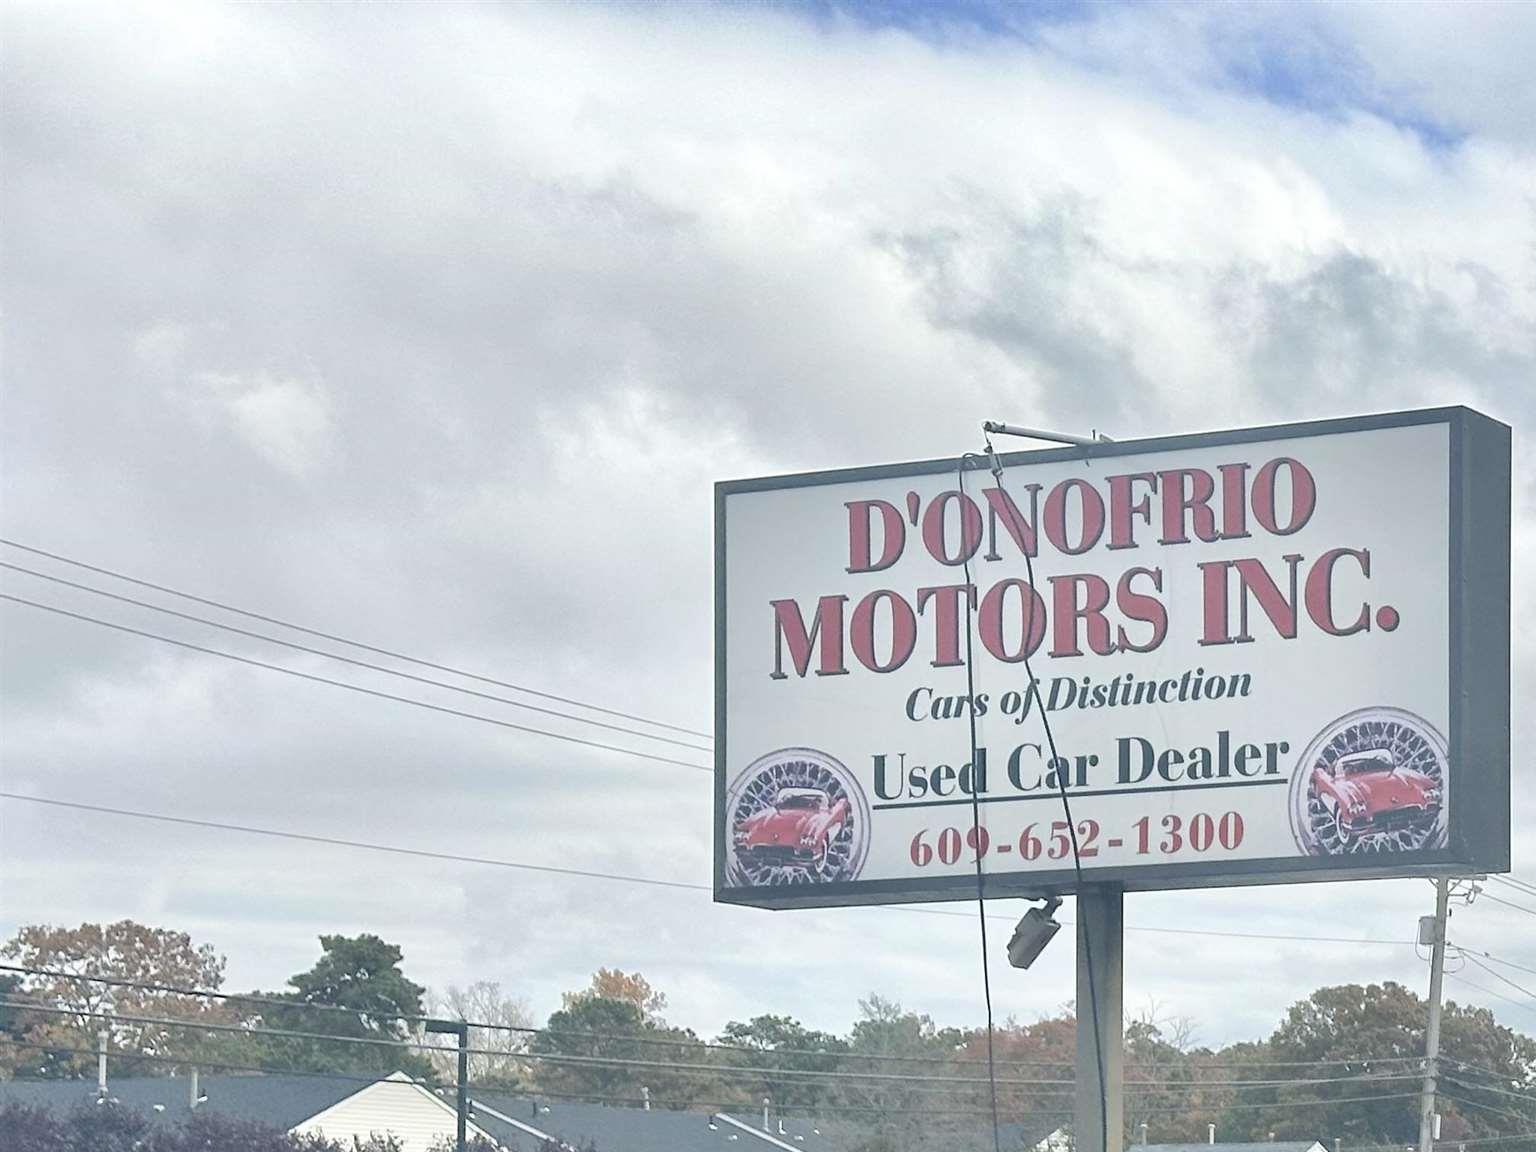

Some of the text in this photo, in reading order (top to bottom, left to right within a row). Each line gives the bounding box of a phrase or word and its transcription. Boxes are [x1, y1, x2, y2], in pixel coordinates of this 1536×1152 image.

[844, 457, 1316, 574] D'ONOFRIO
[769, 548, 1400, 680] MOTORS INC.
[905, 667, 1252, 725] Cars of Distinction
[871, 730, 1290, 801] Used Car Dealer
[910, 811, 1244, 867] 609-652-1300
